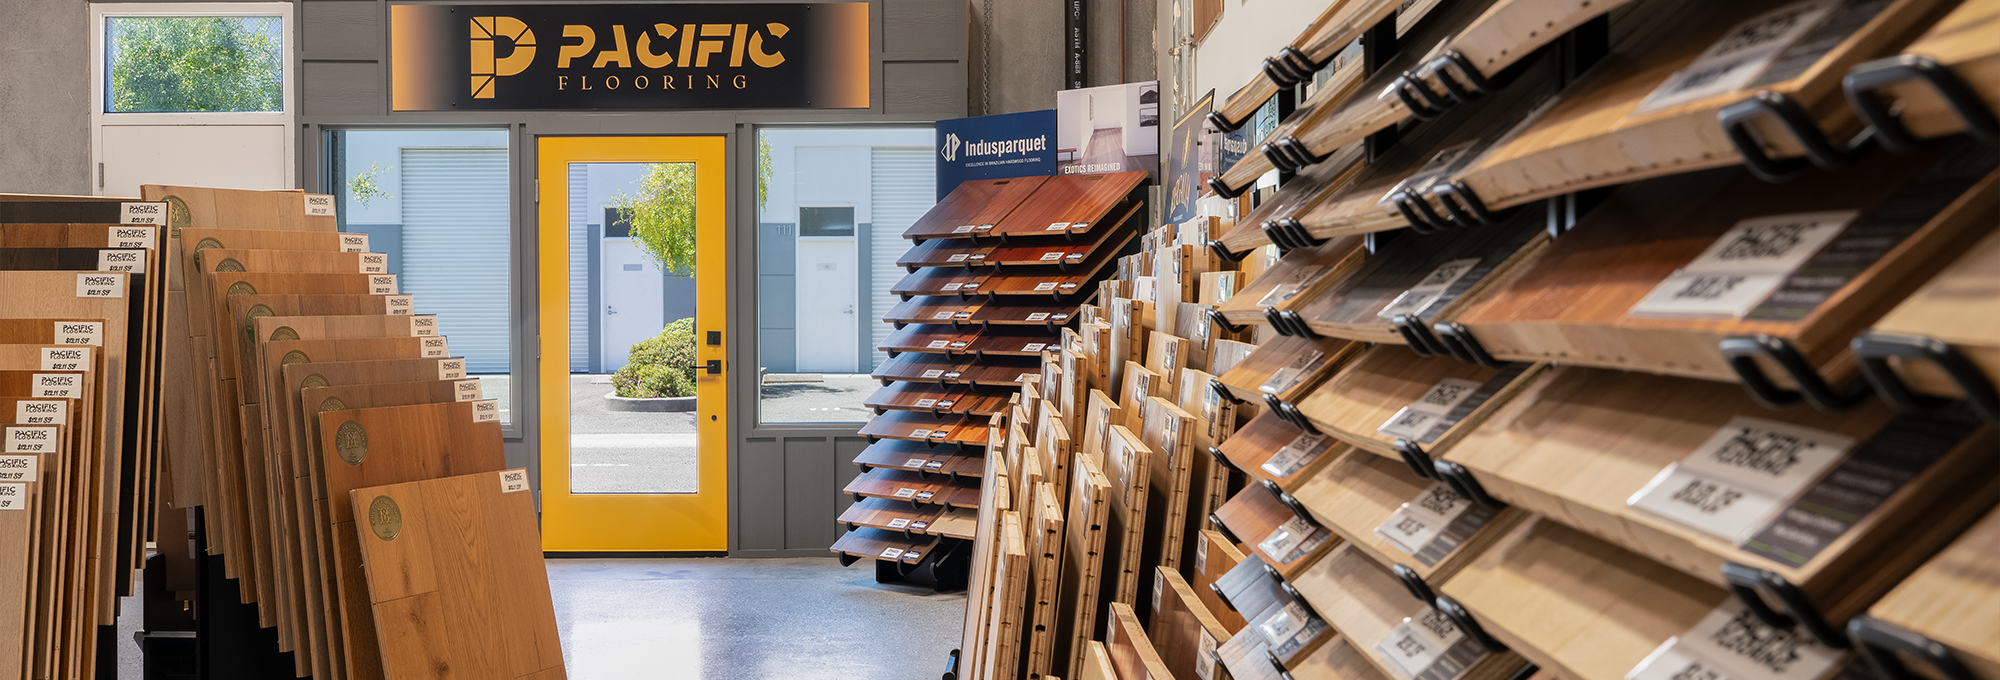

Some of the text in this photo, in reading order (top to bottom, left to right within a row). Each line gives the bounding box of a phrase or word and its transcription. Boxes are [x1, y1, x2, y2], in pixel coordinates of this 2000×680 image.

[557, 22, 790, 69] PACIFIC
[558, 74, 747, 90] FLOORING
[966, 134, 1046, 158] Indusparquet
[1065, 162, 1120, 174] EXOTICS REIMAGINED
[775, 224, 792, 236] 111
